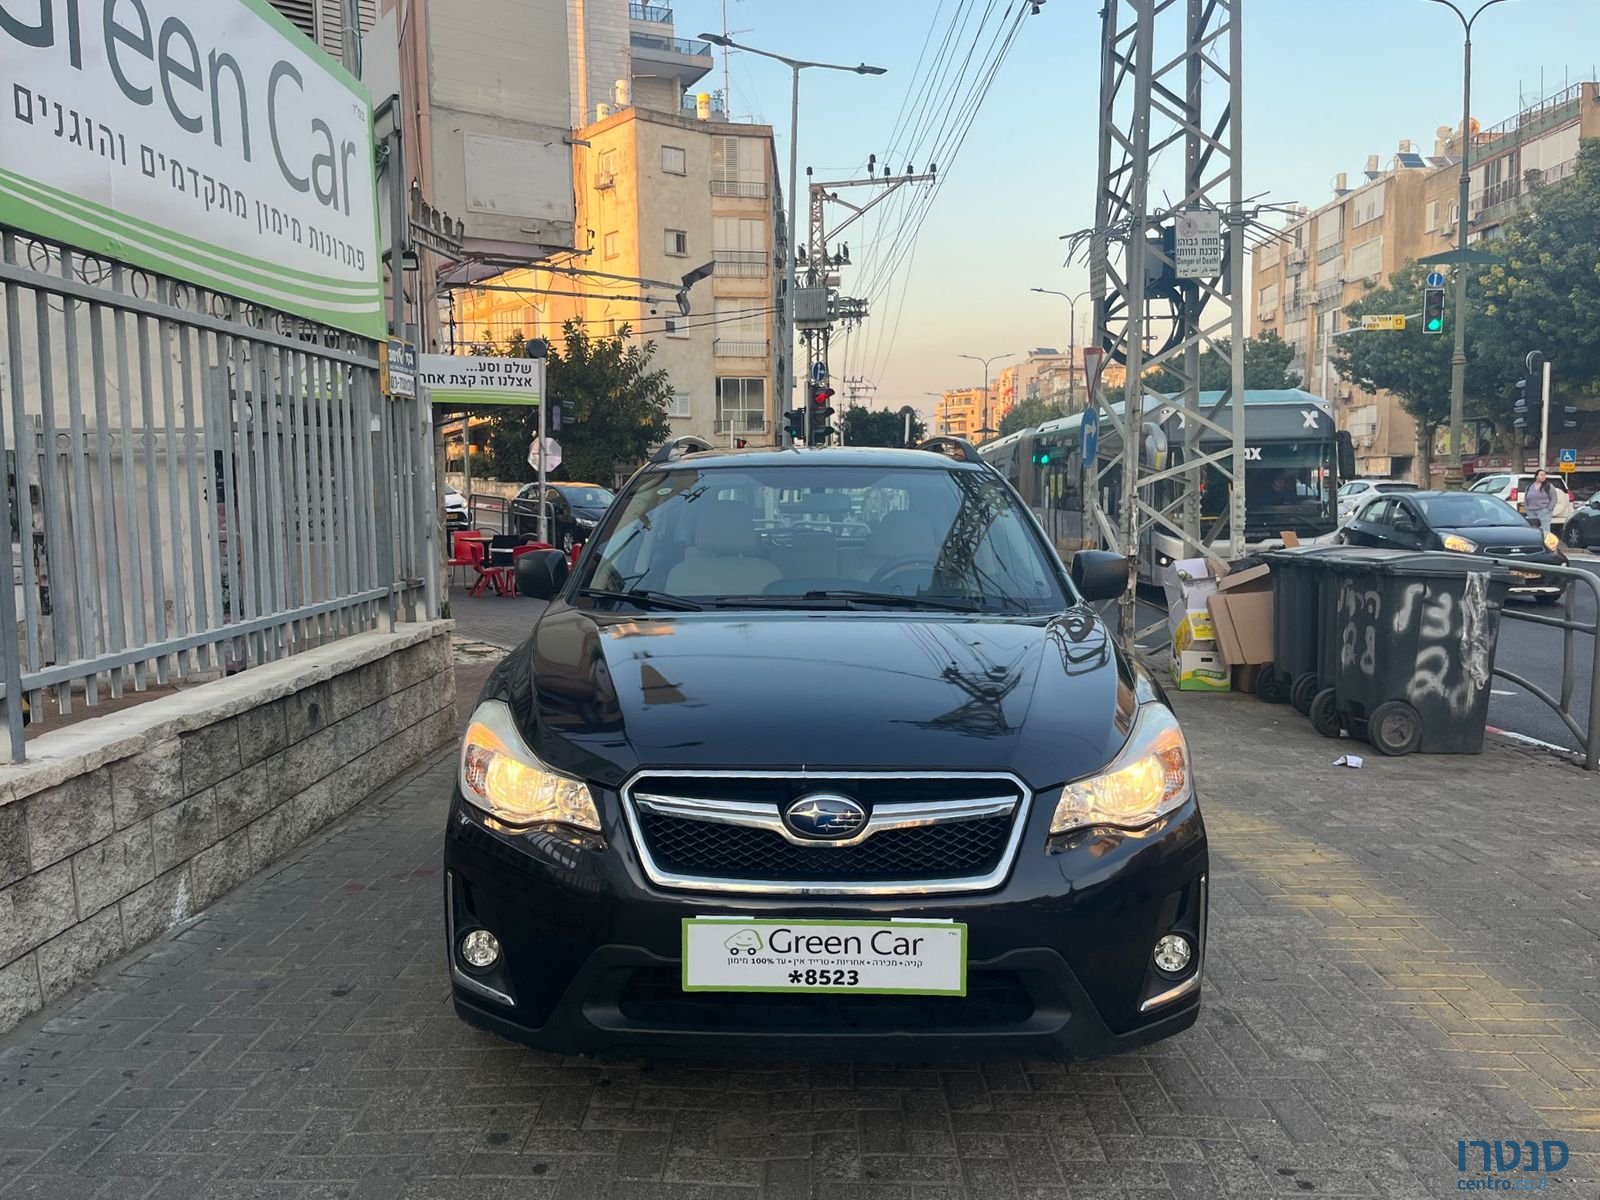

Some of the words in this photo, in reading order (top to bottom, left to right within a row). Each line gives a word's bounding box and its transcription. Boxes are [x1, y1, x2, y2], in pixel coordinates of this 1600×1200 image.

[13, 82, 126, 165] והוגנים
[267, 60, 356, 217] Car
[140, 143, 247, 219] מתקדמים
[255, 199, 302, 244] מימון
[1201, 237, 1218, 246] מתח
[309, 225, 365, 272] פתרונות
[1199, 247, 1218, 256] סכנת
[1177, 258, 1196, 267] Danger
[466, 362, 500, 373] וסע...
[504, 361, 532, 374] שלם
[449, 374, 476, 388] קצת
[481, 376, 494, 386] זה
[498, 376, 532, 387] אצלנו
[1301, 411, 1318, 429] X
[768, 928, 862, 955] Green
[870, 930, 923, 956] Car
[727, 957, 748, 966] מימון
[793, 958, 805, 967] אין
